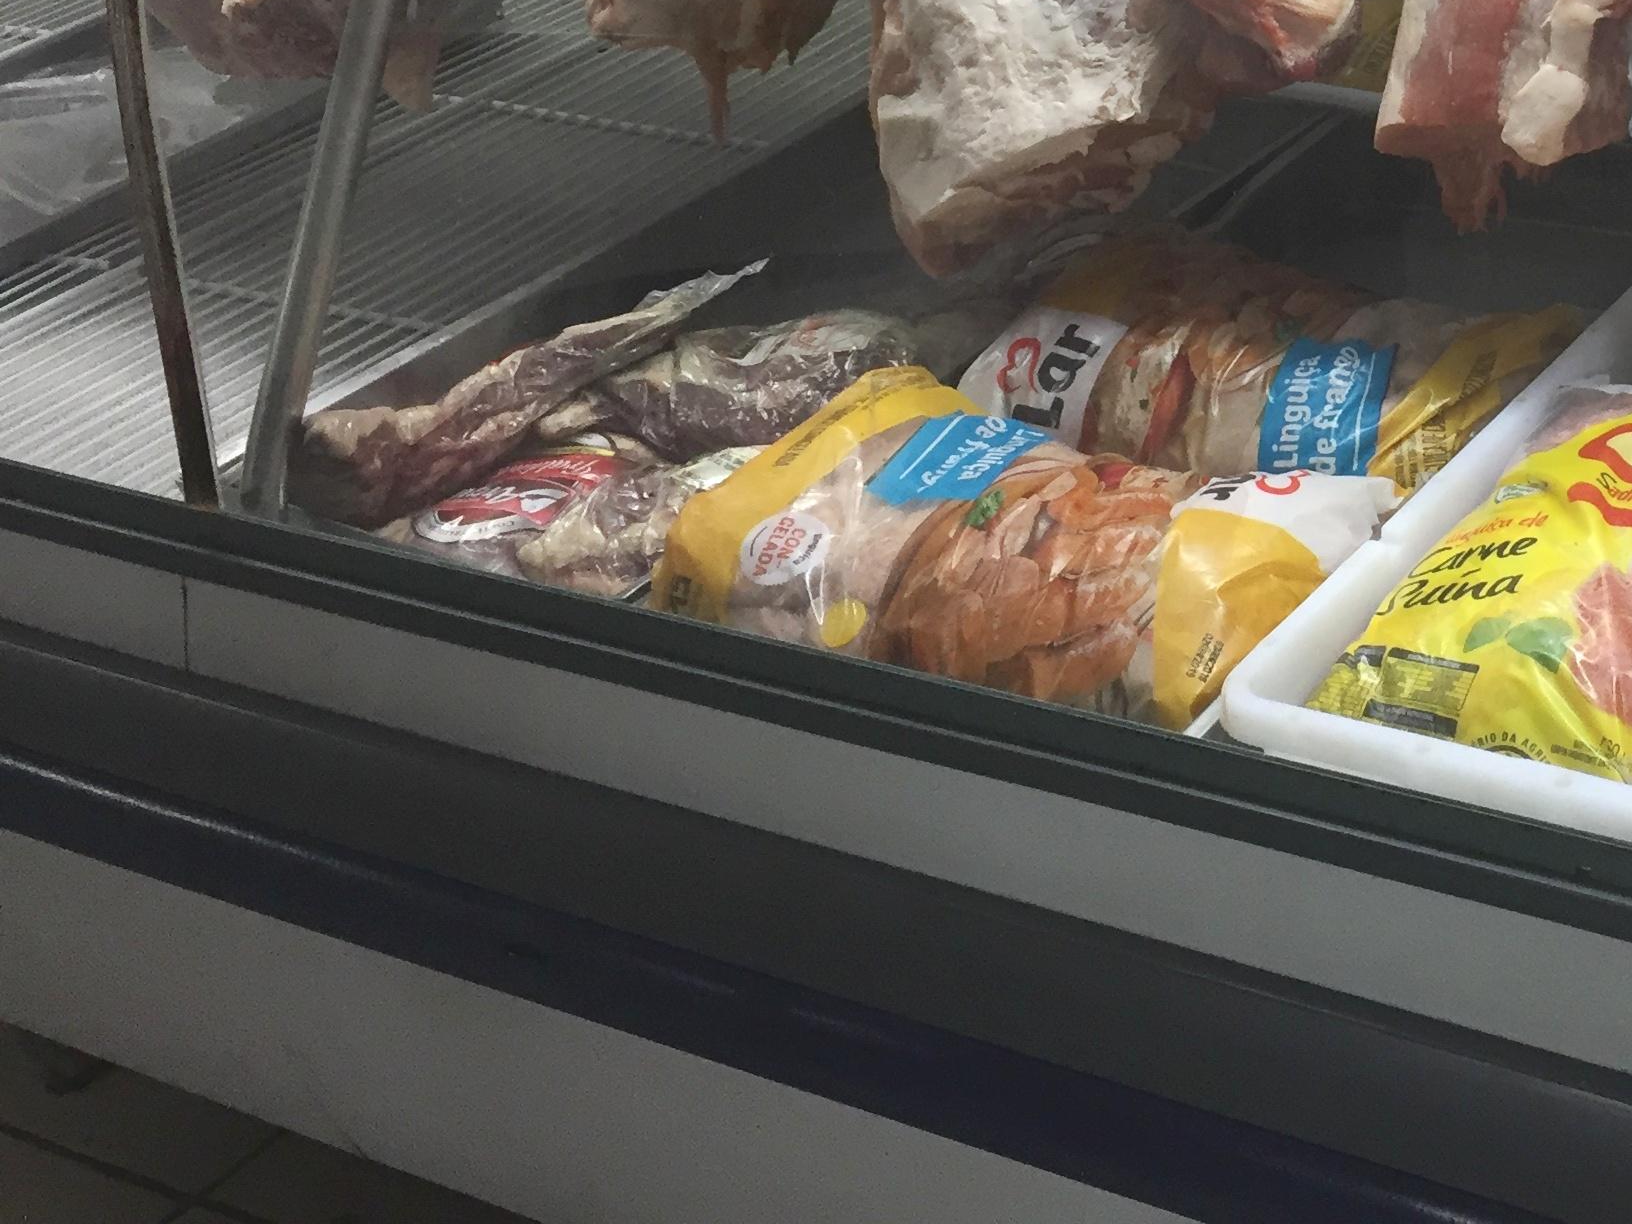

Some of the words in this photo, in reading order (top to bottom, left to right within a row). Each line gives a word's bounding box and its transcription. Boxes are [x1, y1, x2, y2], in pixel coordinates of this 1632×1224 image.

[1011, 323, 1101, 430] Lar
[1272, 355, 1322, 469] Linguiça
[1308, 438, 1338, 476] de
[1519, 511, 1550, 528] de
[752, 516, 796, 577] GELADA
[1407, 536, 1538, 579] Carne
[1375, 568, 1524, 616] Suína
[1501, 730, 1517, 744] DA
